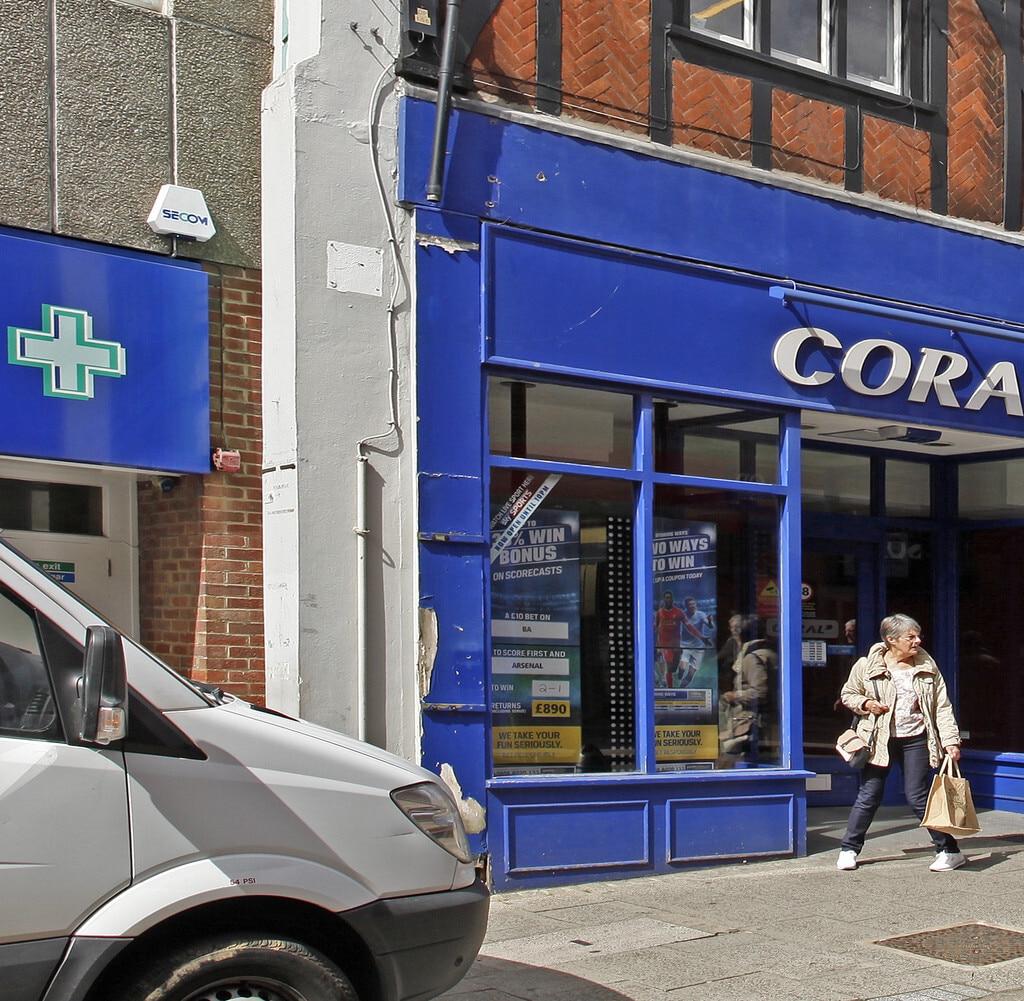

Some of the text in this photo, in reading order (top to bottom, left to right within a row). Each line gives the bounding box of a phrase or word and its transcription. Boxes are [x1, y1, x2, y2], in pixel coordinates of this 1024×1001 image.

[162, 208, 208, 226] SECOM
[510, 489, 532, 516] SPORTS
[494, 485, 550, 552] NOW OPEN UNTIL 10PM
[529, 527, 565, 544] WIN
[669, 537, 708, 553] WAYS
[499, 545, 557, 565] BONUS
[668, 555, 695, 570] WIN
[42, 563, 61, 571] exit
[493, 566, 562, 581] ON SCORECASTS
[502, 649, 525, 657] SCORE
[535, 703, 567, 714] £890
[498, 731, 561, 740] WE TAKE YOUR
[663, 730, 680, 738] TAKE
[681, 730, 701, 738] YOUR
[496, 740, 563, 749] FUN SERIOUSLY.
[663, 739, 703, 747] SERIOUSLY.
